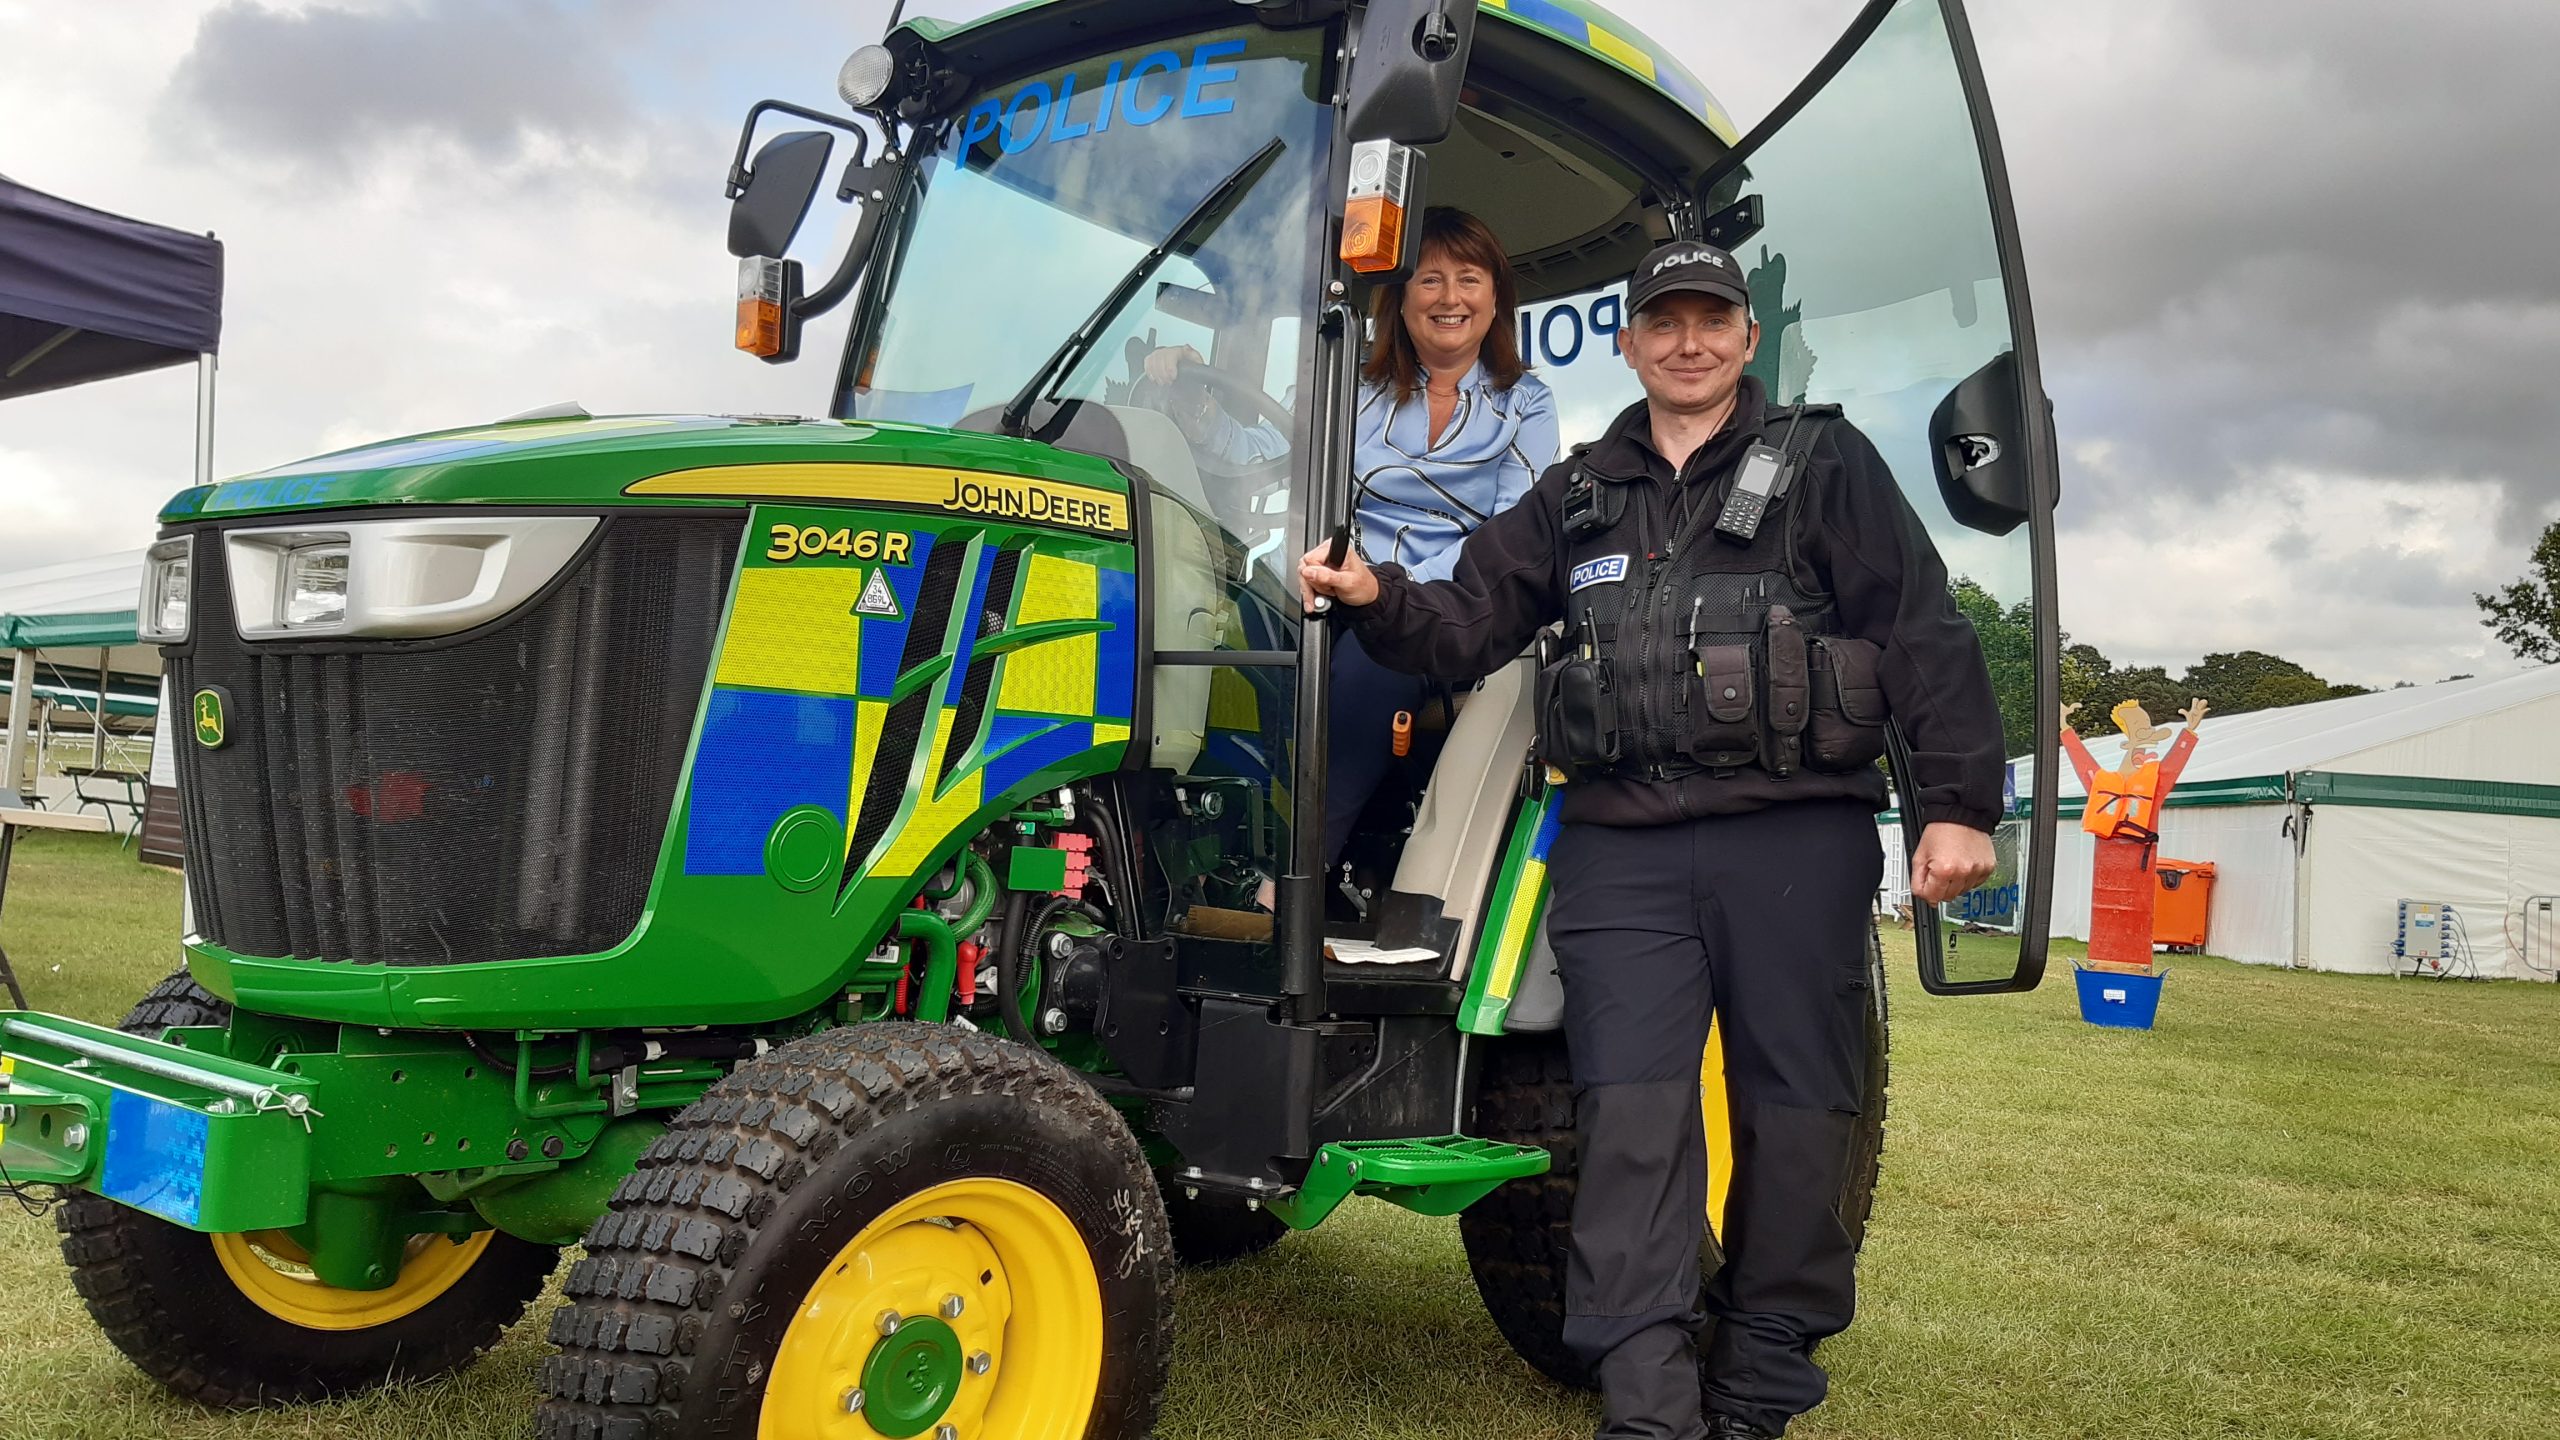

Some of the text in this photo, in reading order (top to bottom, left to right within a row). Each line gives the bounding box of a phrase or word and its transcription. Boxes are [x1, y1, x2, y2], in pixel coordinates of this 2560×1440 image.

[955, 39, 1247, 170] POLICE
[1652, 251, 1724, 277] POLICE
[214, 477, 336, 510] POLICE
[943, 477, 1113, 528] JOHN DEERE
[1573, 559, 1621, 586] POLICE
[799, 1142, 912, 1243] MOW
